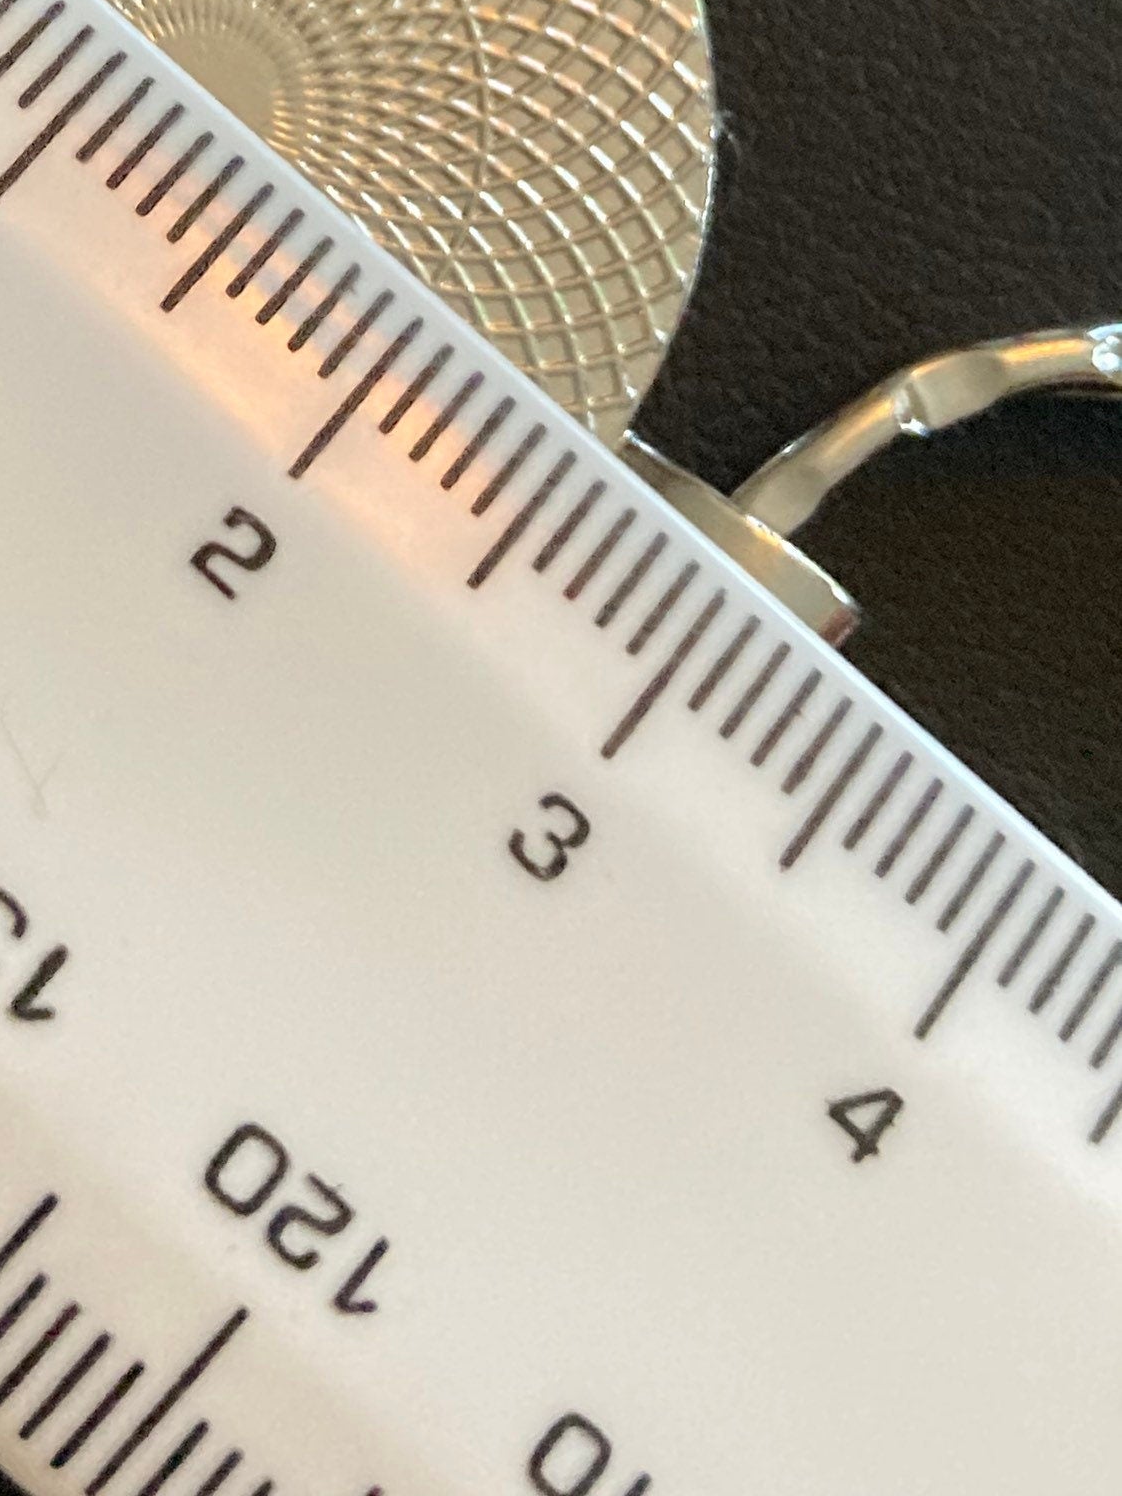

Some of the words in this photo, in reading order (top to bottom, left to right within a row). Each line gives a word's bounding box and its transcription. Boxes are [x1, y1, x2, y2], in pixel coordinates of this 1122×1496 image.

[187, 504, 279, 603] 2
[506, 792, 593, 884] 3
[826, 1083, 908, 1165] 4
[202, 1122, 391, 1316] 120
